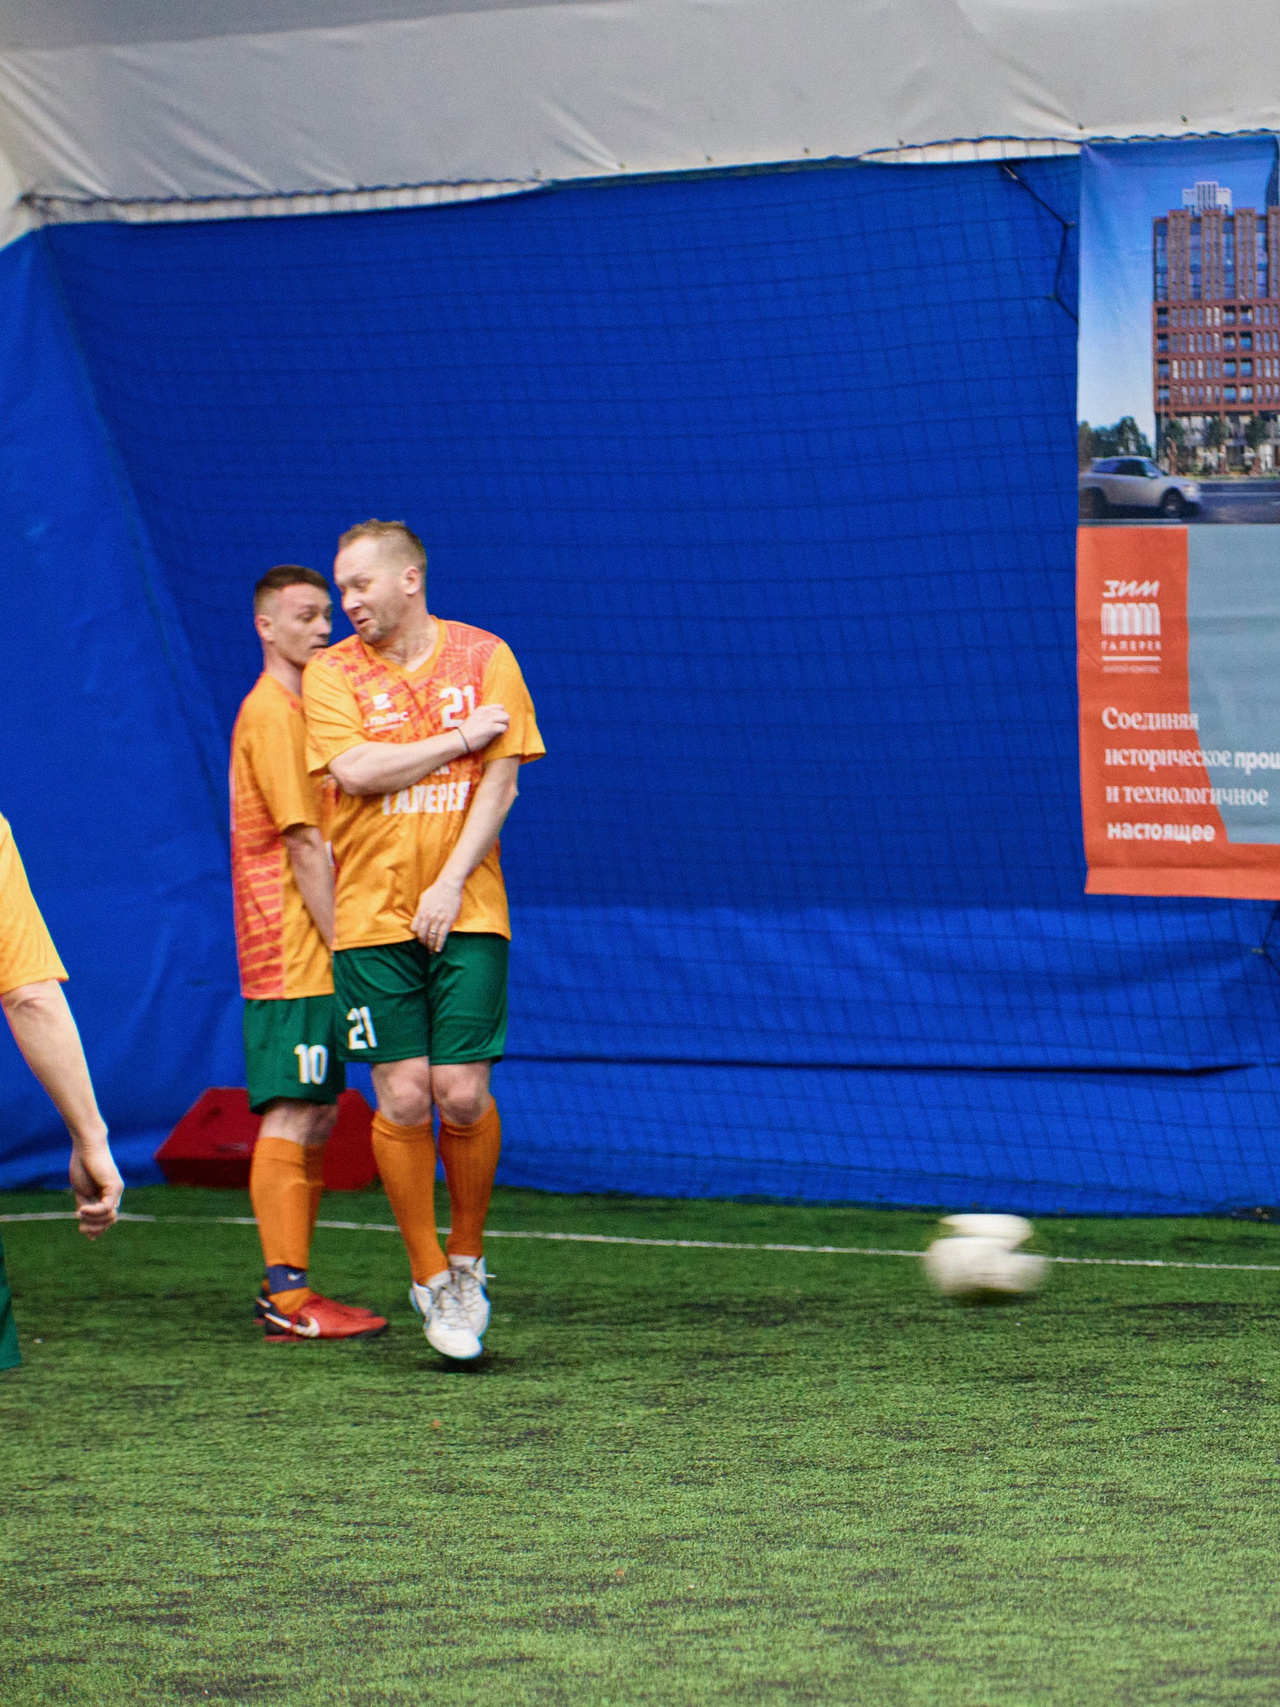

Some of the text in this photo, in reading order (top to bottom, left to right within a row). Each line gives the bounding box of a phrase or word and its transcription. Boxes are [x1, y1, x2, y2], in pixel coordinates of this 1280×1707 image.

[438, 685, 476, 729] 21
[1102, 706, 1199, 730] Соединяя
[1105, 748, 1232, 772] историческое
[1105, 785, 1269, 806] и технологичное
[1107, 822, 1216, 845] настоящее
[346, 1006, 378, 1050] 21
[294, 1043, 329, 1085] 10
